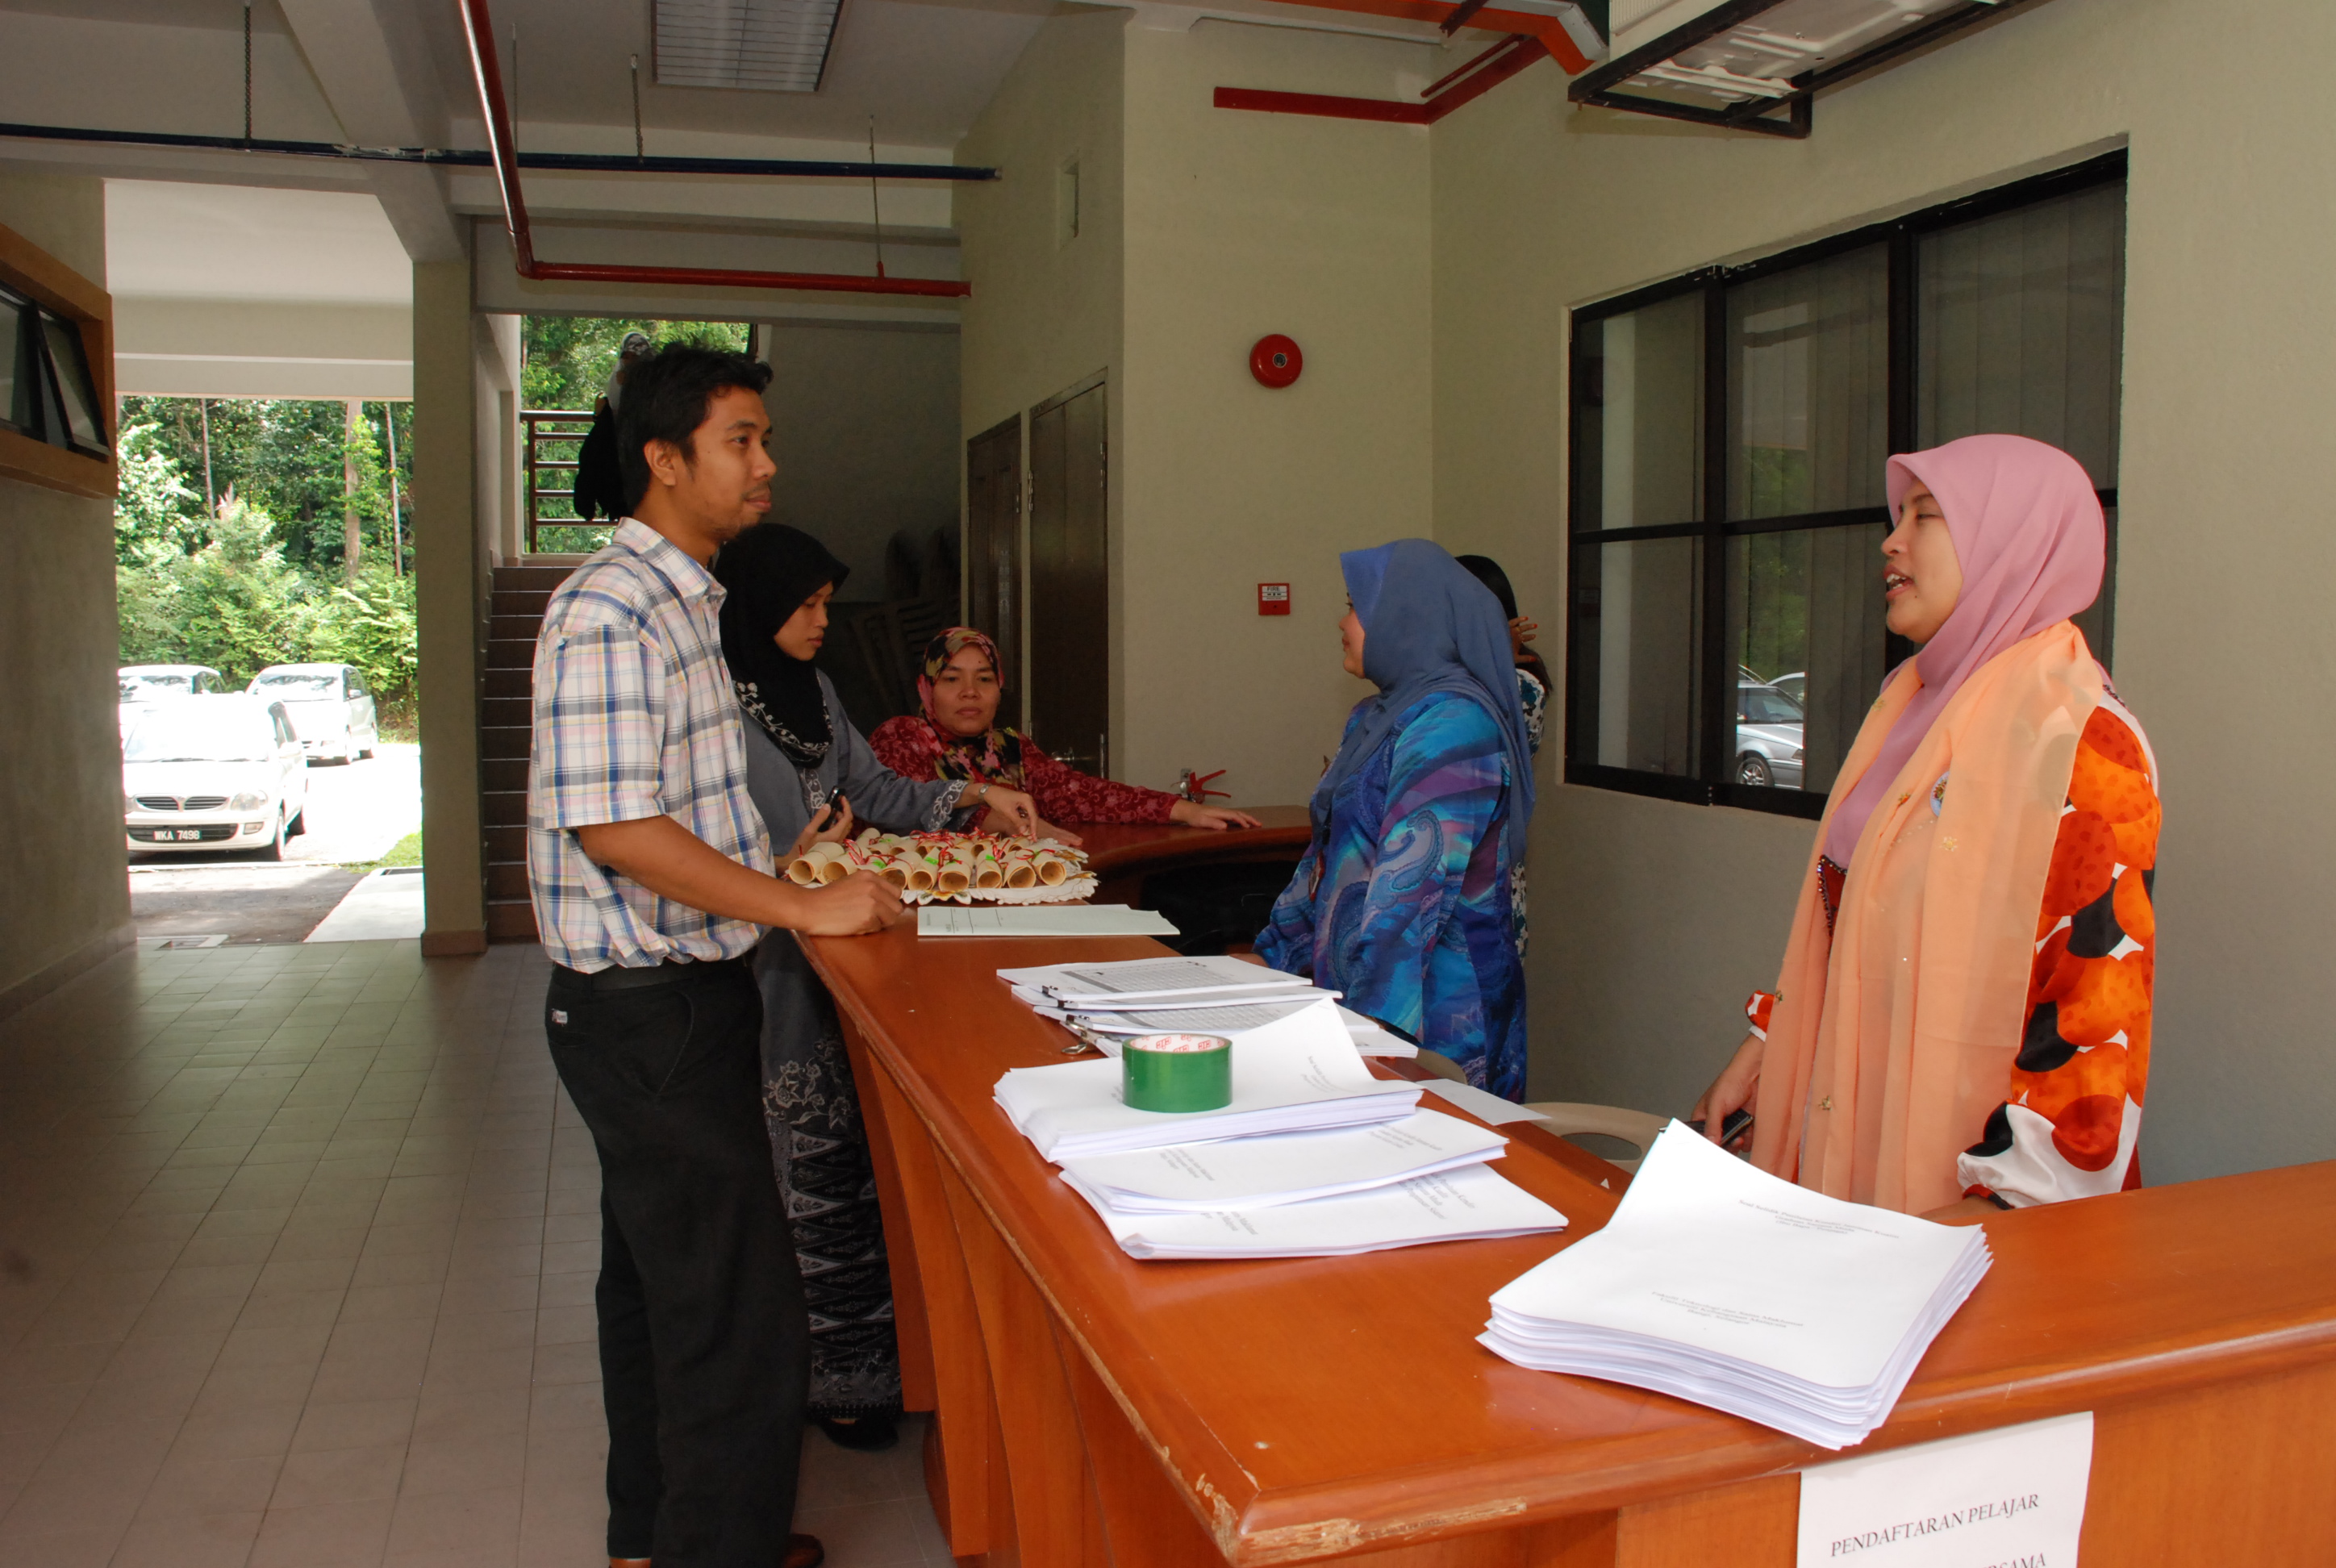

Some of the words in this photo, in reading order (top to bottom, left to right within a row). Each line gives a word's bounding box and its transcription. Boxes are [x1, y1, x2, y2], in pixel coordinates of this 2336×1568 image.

[153, 830, 174, 841] WKA
[177, 829, 201, 840] 7498
[1829, 1510, 1965, 1558] PENDAFTARAN
[1967, 1493, 2039, 1524] PELAJAR
